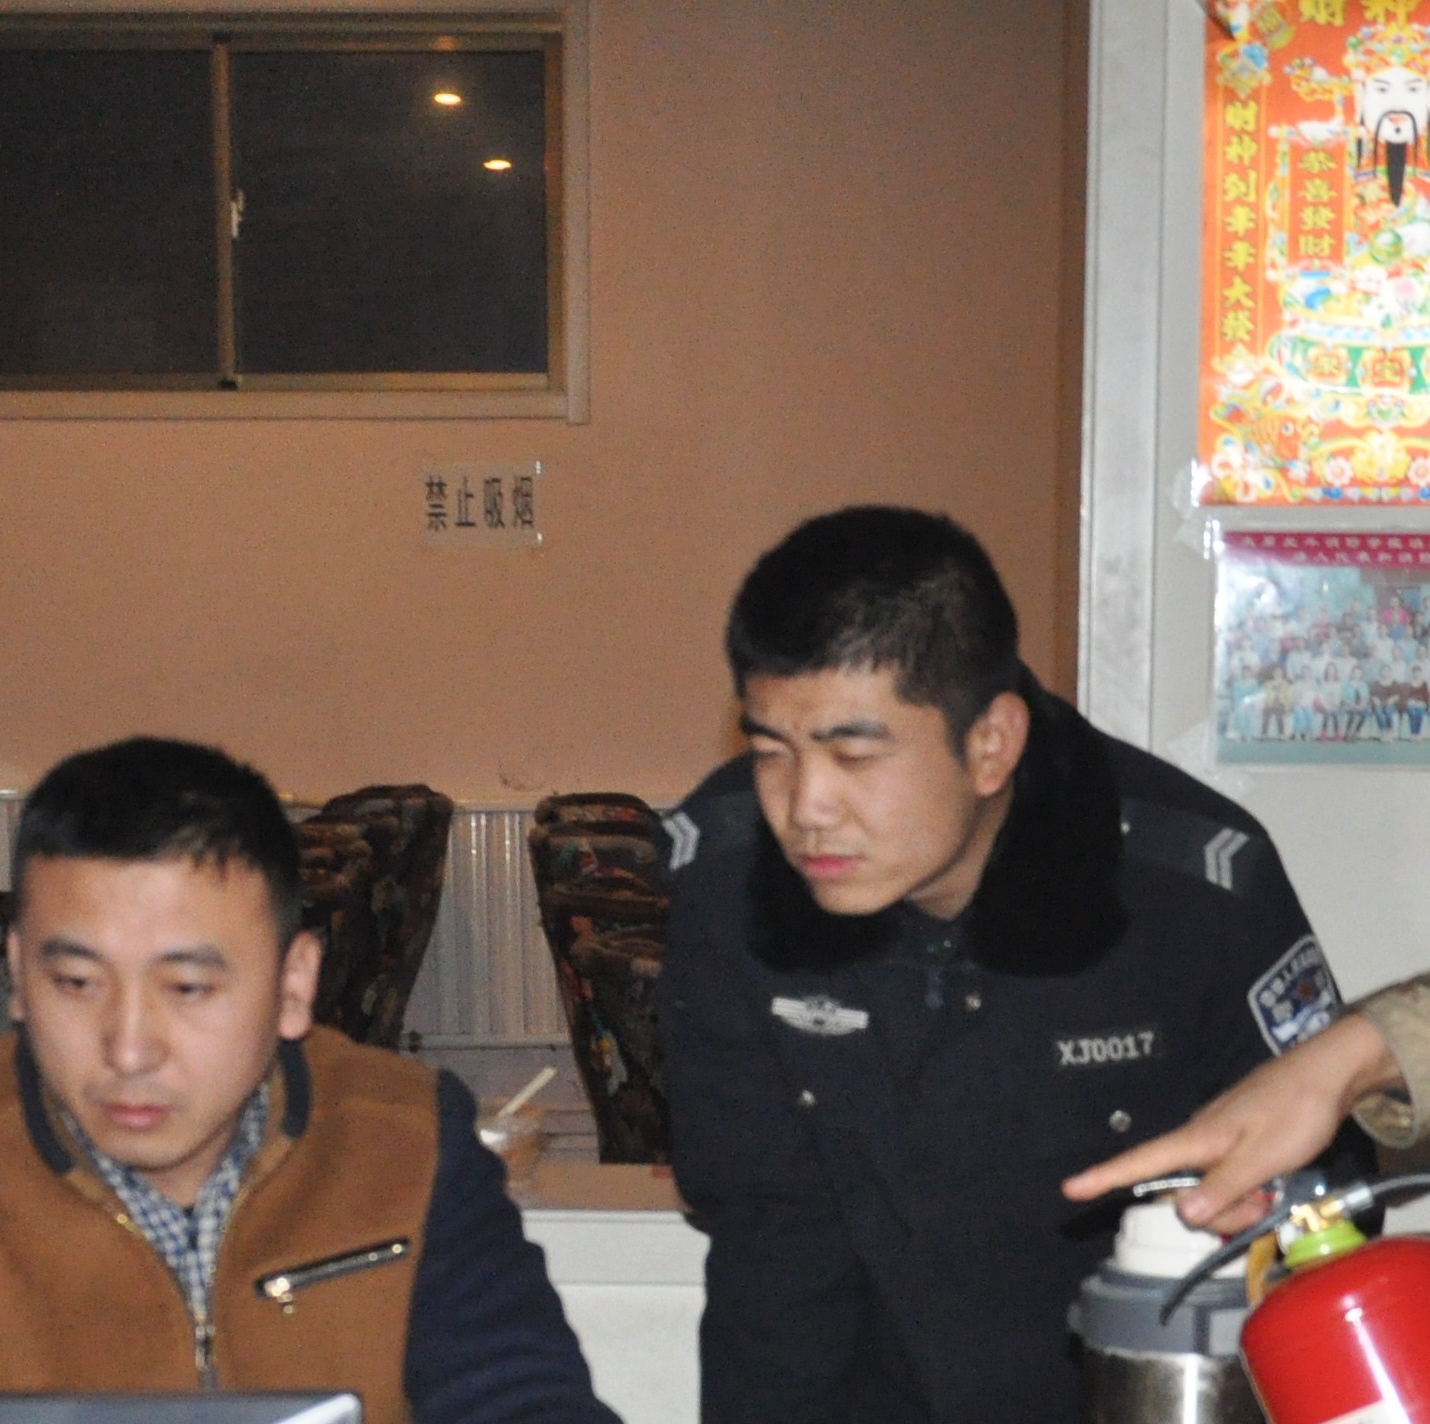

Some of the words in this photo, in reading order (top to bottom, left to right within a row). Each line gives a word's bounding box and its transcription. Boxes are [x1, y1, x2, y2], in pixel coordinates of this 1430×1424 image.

[1298, 150, 1338, 257] 恭喜發財
[425, 474, 534, 532] 禁止吸烟
[1056, 1030, 1155, 1066] XJ0017
